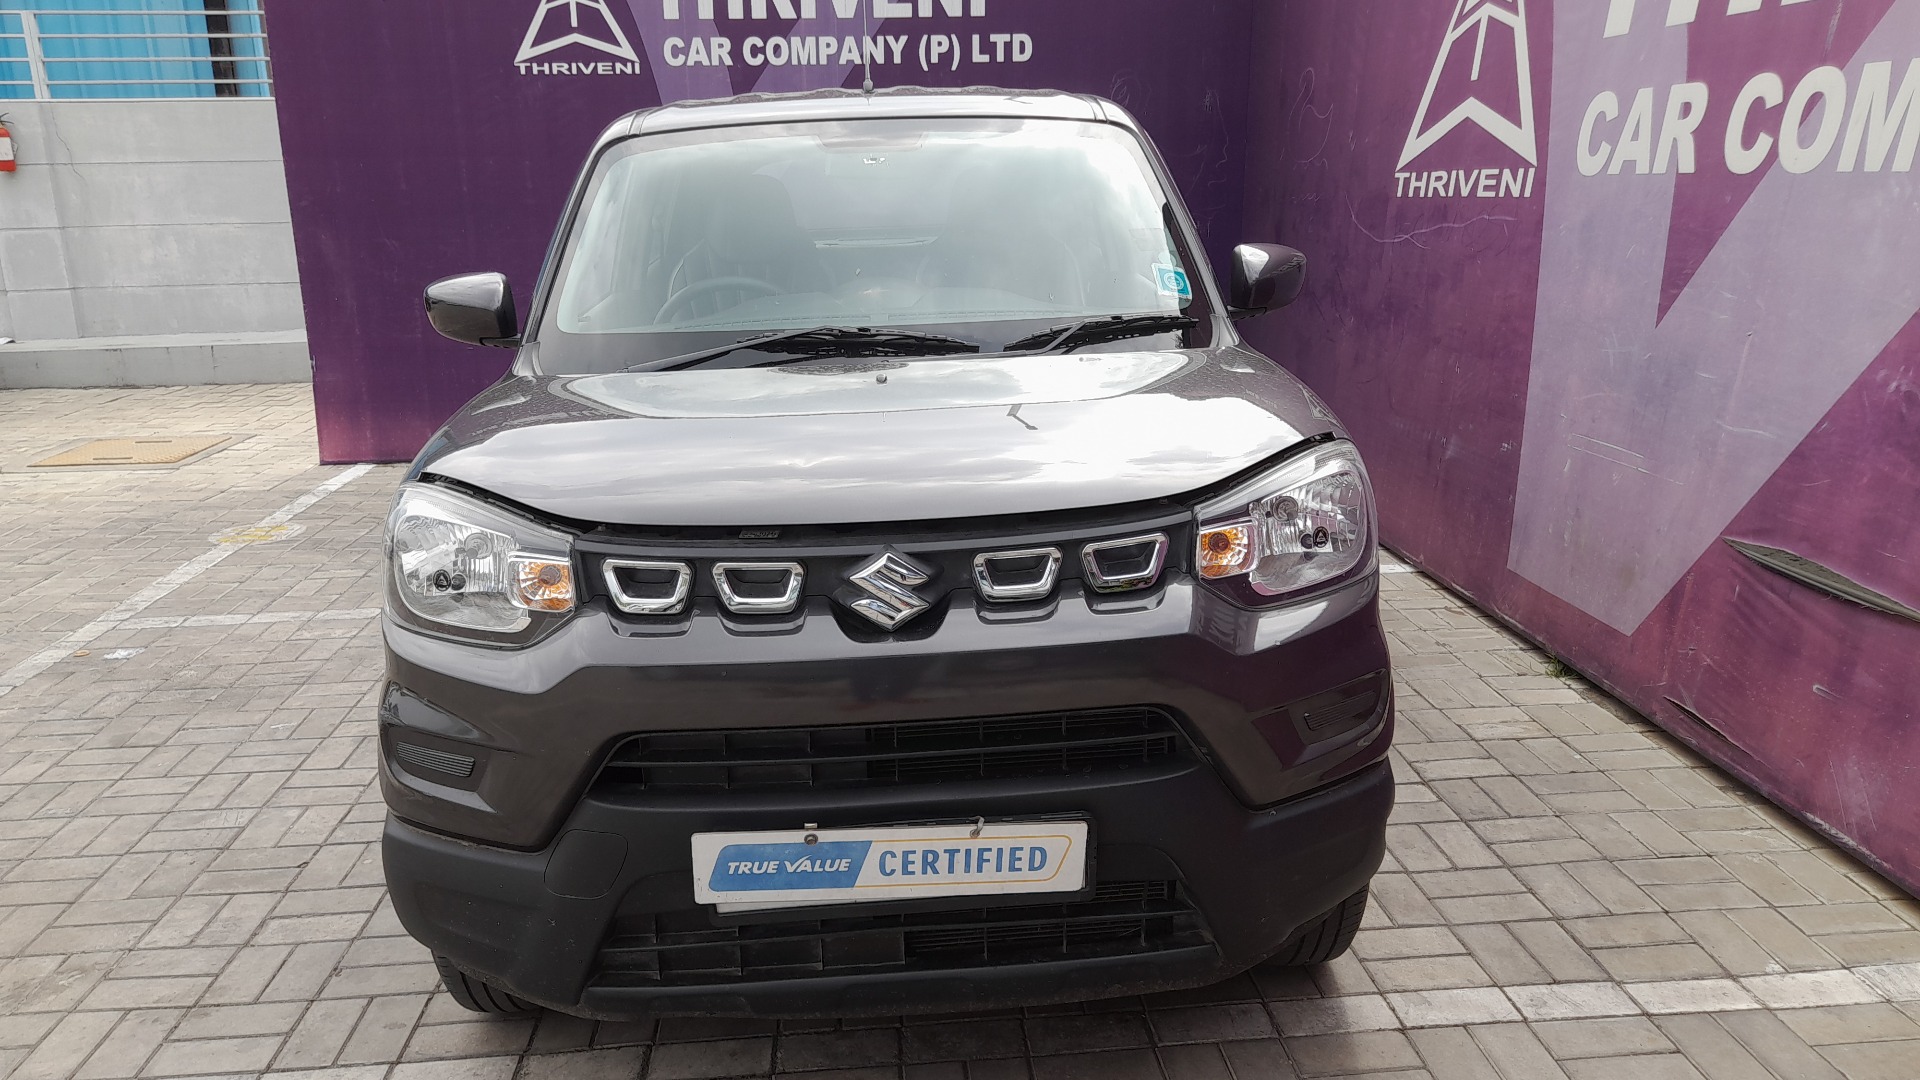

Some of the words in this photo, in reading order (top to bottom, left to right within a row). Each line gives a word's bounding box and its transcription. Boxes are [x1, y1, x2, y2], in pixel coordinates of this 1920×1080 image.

[663, 36, 734, 67] CAR
[742, 35, 909, 67] COMPANY
[918, 34, 961, 72] (P)
[971, 33, 1033, 63] LTD
[517, 62, 640, 75] THRIVENI
[1576, 82, 1709, 177] CAR
[1724, 57, 1920, 175] COM
[1394, 167, 1536, 198] THRIVENI
[728, 860, 780, 875] TRUE
[784, 854, 852, 873] VALUE
[878, 846, 1048, 877] CERTIFIED
